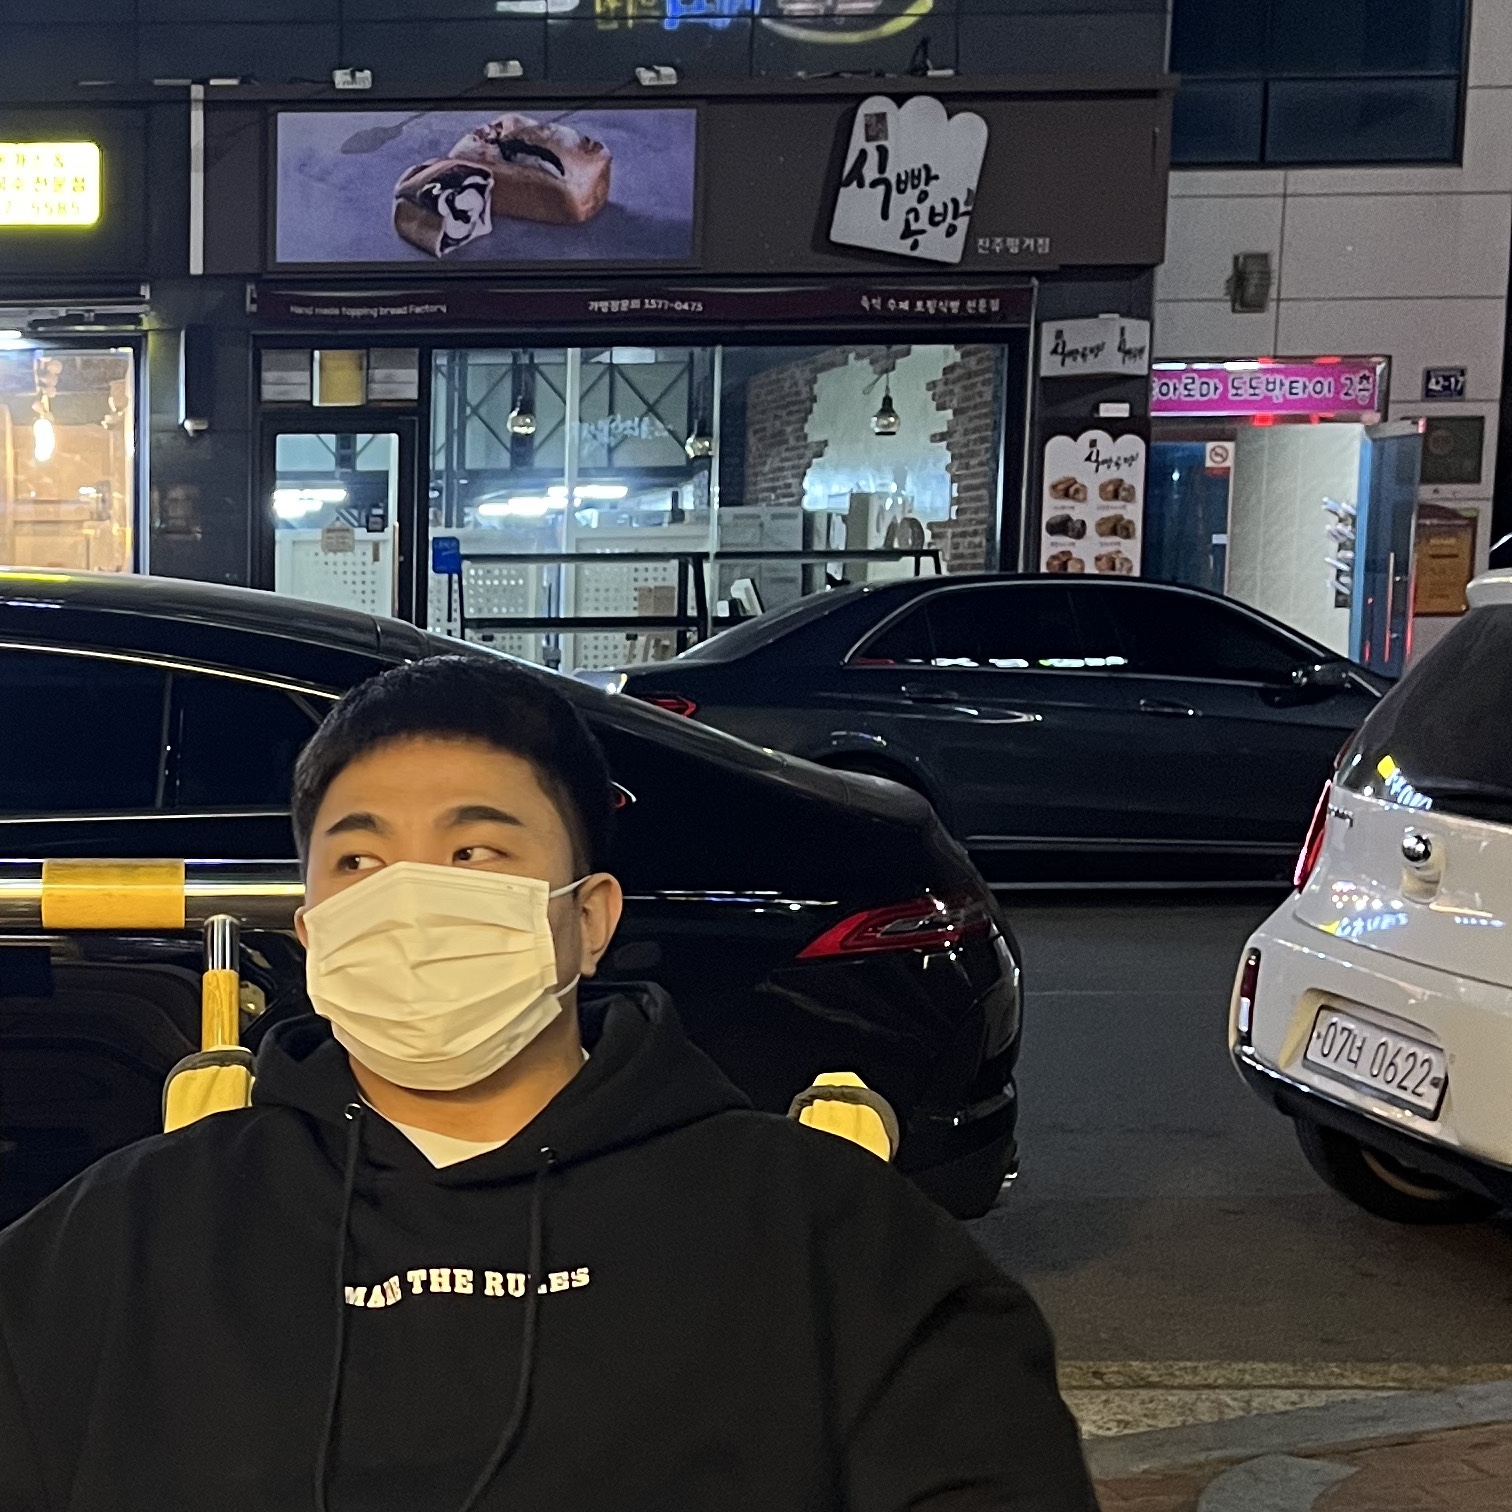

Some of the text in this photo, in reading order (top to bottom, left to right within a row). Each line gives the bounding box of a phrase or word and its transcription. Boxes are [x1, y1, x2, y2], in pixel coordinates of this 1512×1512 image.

[1369, 1039, 1434, 1098] 0622
[406, 1266, 474, 1296] THE
[484, 1266, 590, 1298] RUES
